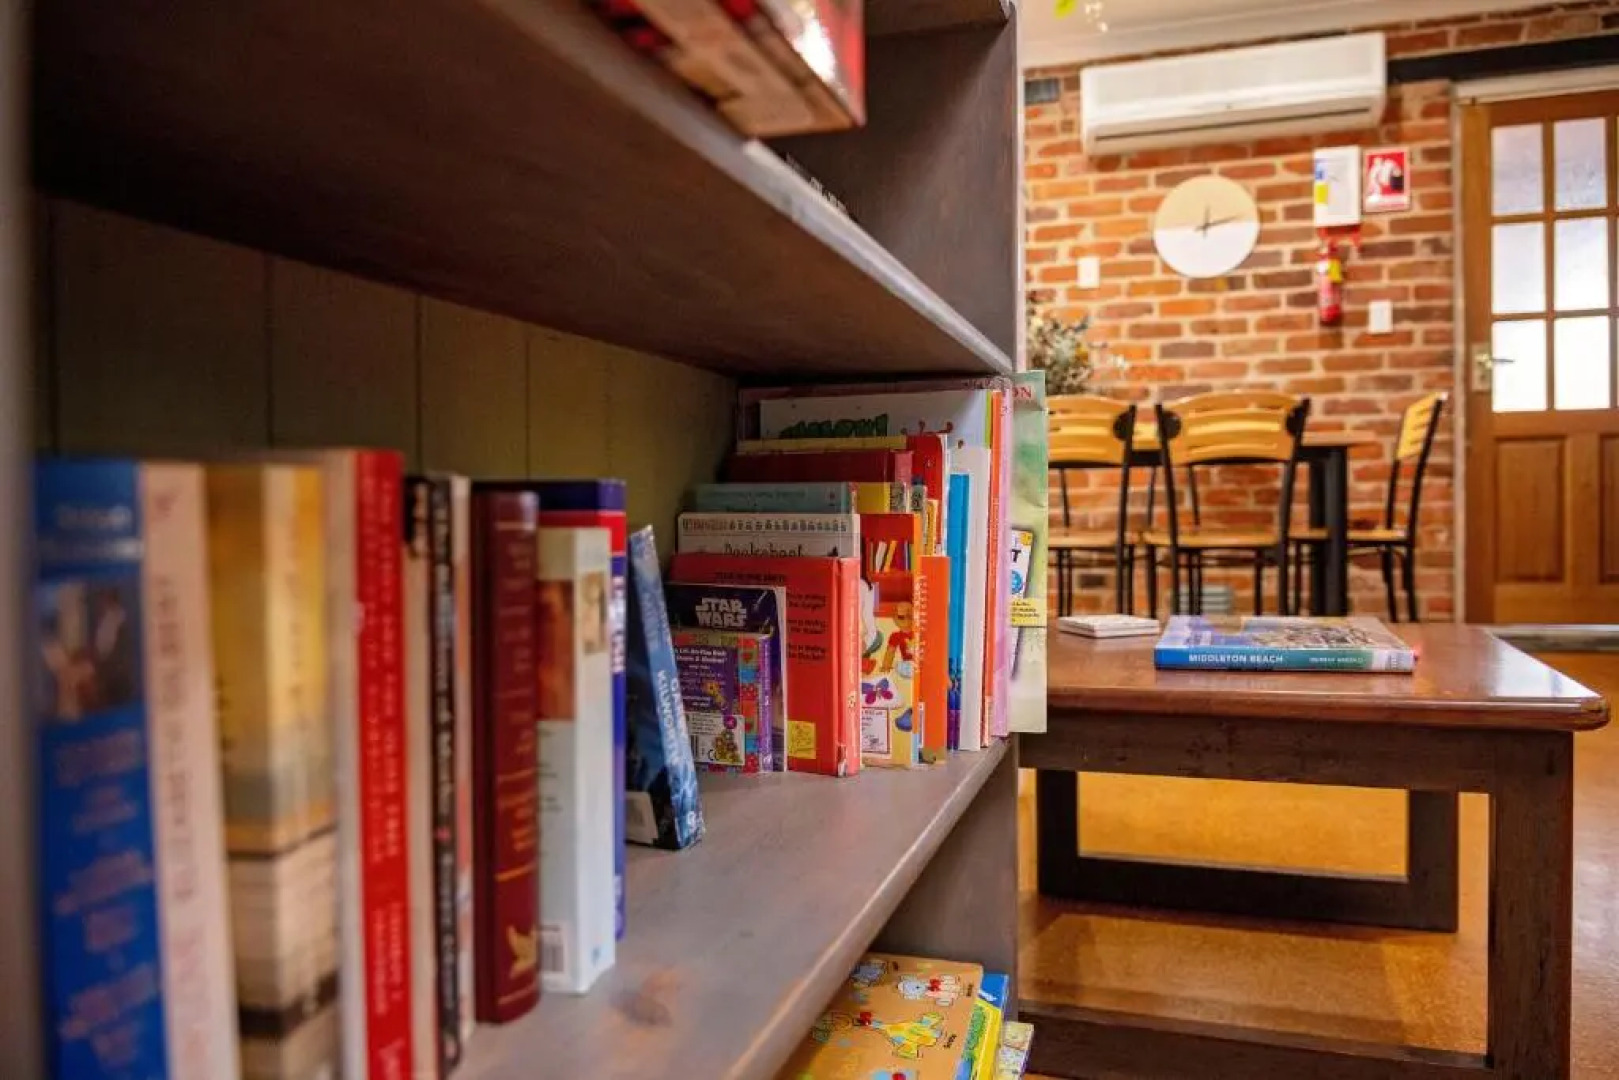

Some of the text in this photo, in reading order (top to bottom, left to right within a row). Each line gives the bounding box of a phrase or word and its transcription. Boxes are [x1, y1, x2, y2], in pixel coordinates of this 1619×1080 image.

[695, 597, 747, 613] STAR
[696, 612, 747, 628] WARS
[1188, 653, 1283, 664] MIDDLETON BEACH
